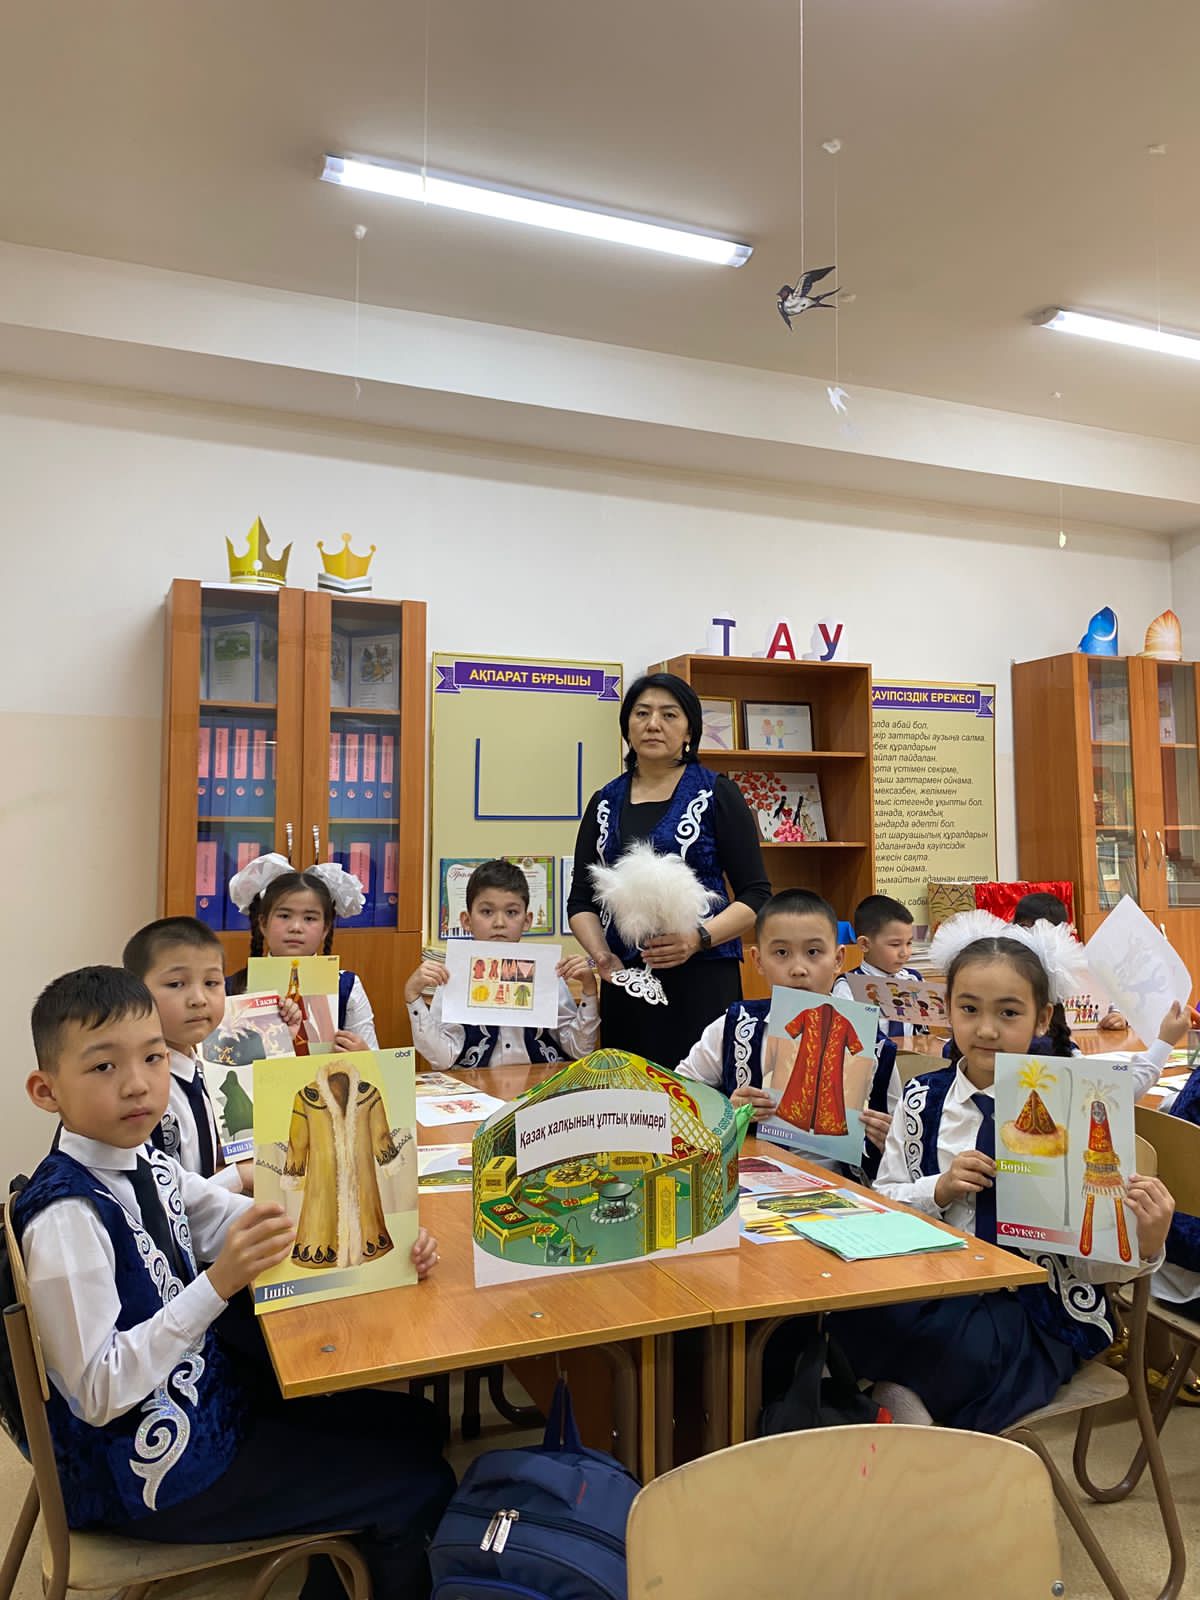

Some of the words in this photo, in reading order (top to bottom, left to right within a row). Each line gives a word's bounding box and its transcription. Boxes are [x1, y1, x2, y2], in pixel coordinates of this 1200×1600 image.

[469, 668, 527, 684] АҚПАРАТ
[531, 671, 591, 686] БҰРЫШЫ
[931, 694, 975, 704] ЕРЕЖЕСІ
[872, 720, 890, 729] олда
[892, 720, 911, 729] абай
[888, 732, 930, 742] заттарды
[874, 742, 887, 751] бек
[889, 742, 936, 753] құралдарын
[873, 753, 897, 762] айлап
[874, 765, 891, 774] рта
[893, 765, 926, 774] үстімен
[895, 777, 942, 786] заттармен
[874, 786, 918, 796] мексазбен,
[874, 798, 892, 806] мыс
[893, 797, 934, 807] істегенде
[874, 809, 905, 818] ханада,
[906, 809, 944, 819] қоғамдық
[874, 819, 909, 829] ындарда
[875, 841, 925, 851] йдаланғанда
[876, 853, 902, 862] ежесін
[876, 865, 894, 873] ппен
[876, 875, 920, 885] нымайтын
[520, 1129, 546, 1149] Қазақ
[547, 1114, 595, 1134] халқының
[597, 1111, 629, 1129] ұлттық
[629, 1109, 667, 1131] киімдері
[264, 1283, 294, 1300] Ішік
